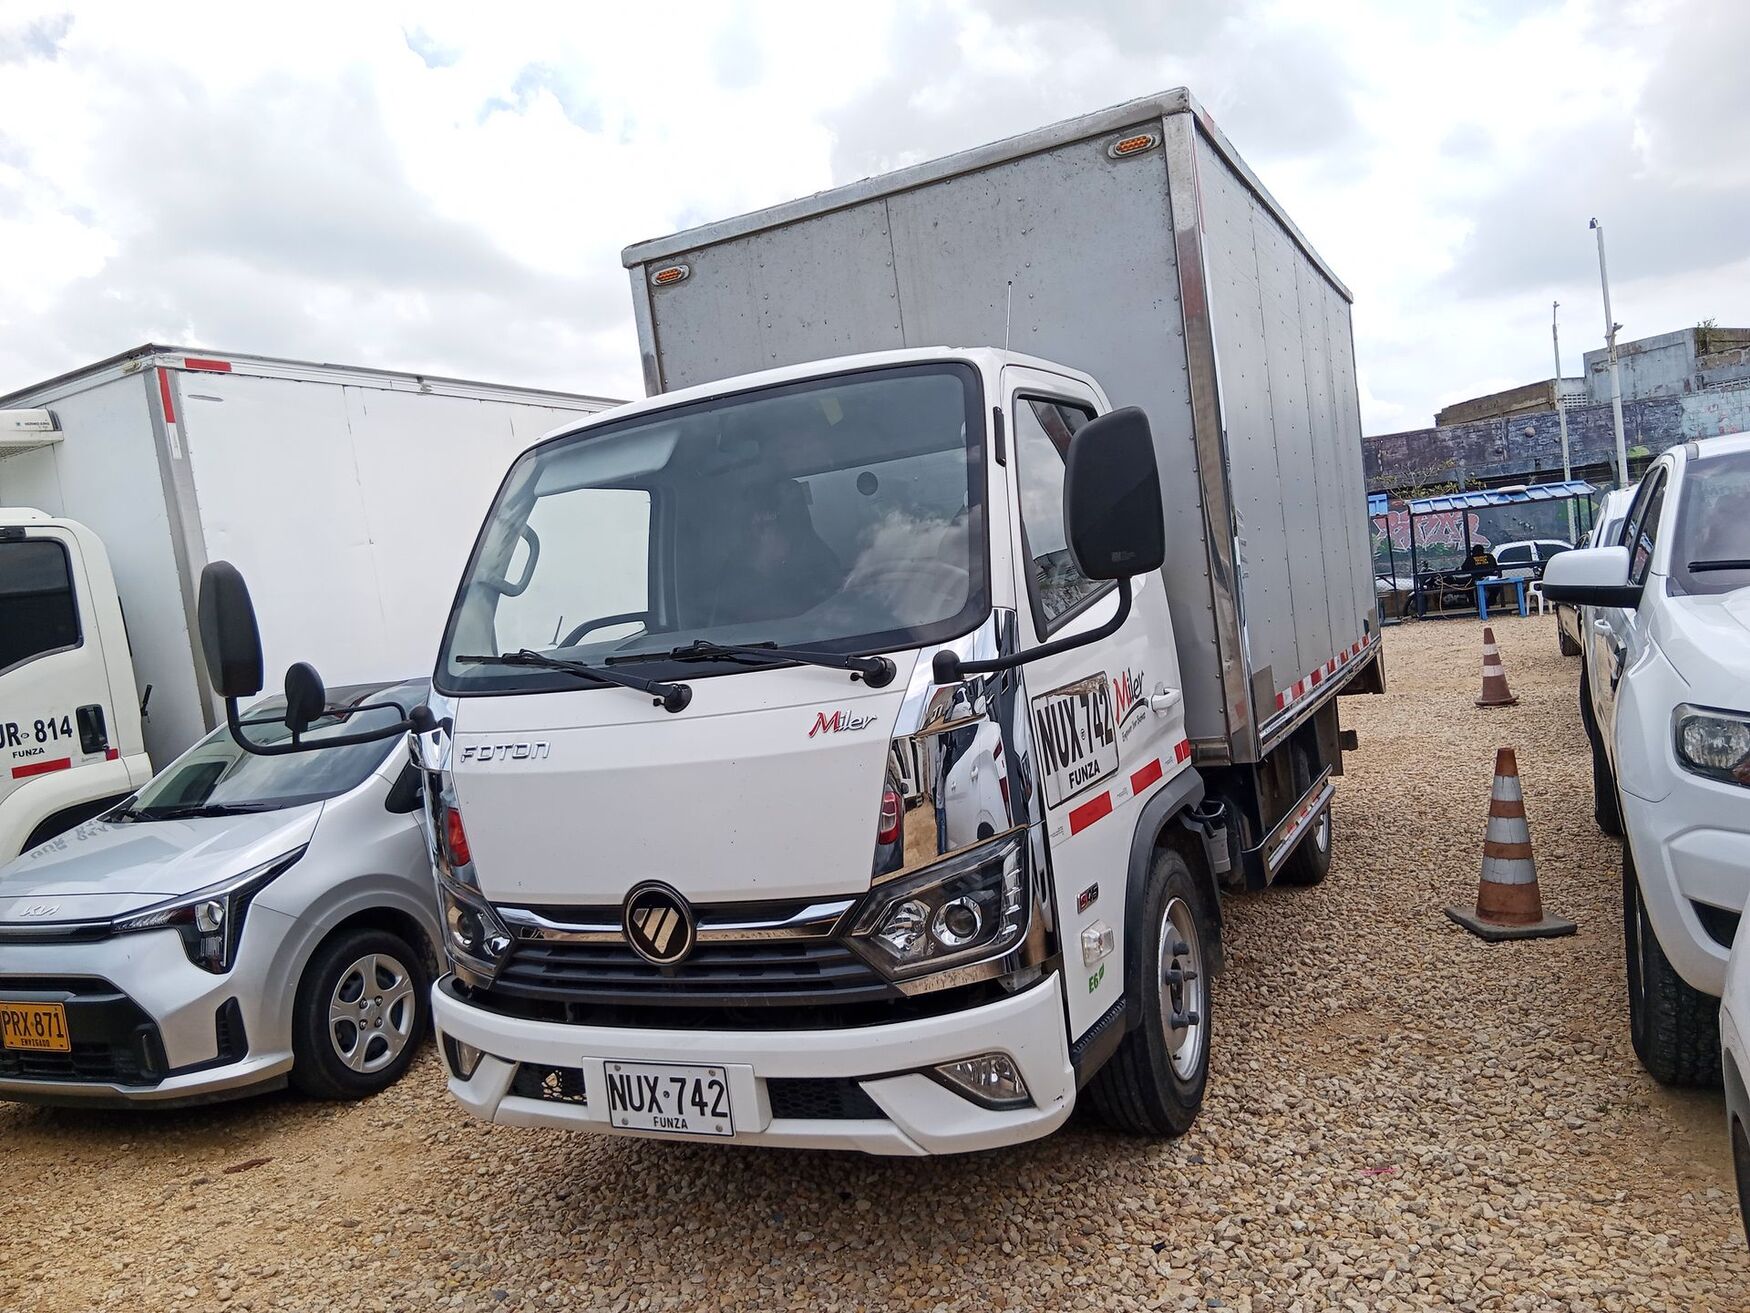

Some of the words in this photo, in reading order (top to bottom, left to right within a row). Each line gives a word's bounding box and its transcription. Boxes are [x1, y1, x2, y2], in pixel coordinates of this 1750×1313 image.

[1113, 667, 1145, 725] Miler
[34, 715, 73, 743] 814
[808, 710, 878, 738] Miler
[12, 747, 45, 759] FUNZA
[460, 740, 551, 763] FOTON
[1069, 759, 1101, 789] FUNZA
[653, 1115, 689, 1130] FUNZA
